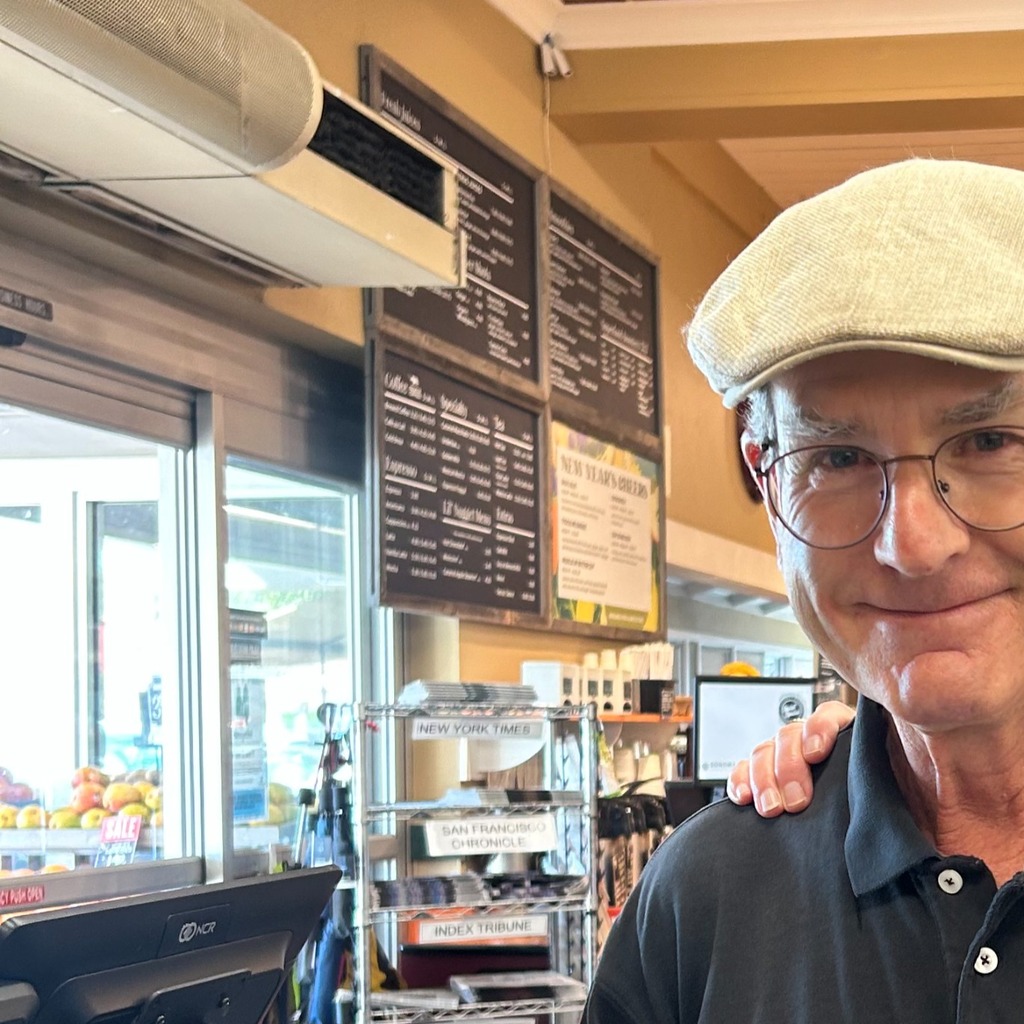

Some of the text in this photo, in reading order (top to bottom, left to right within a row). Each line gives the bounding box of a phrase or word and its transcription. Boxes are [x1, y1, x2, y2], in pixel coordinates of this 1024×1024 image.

[561, 454, 583, 479] NEW
[419, 724, 531, 735] NEW YORK TIMES
[105, 816, 138, 840] SALE
[442, 821, 547, 837] SAN FRANCISCO
[452, 836, 527, 850] CHRONICLE
[196, 920, 217, 936] NCR
[435, 920, 532, 937] INDEX TRIBUNE
